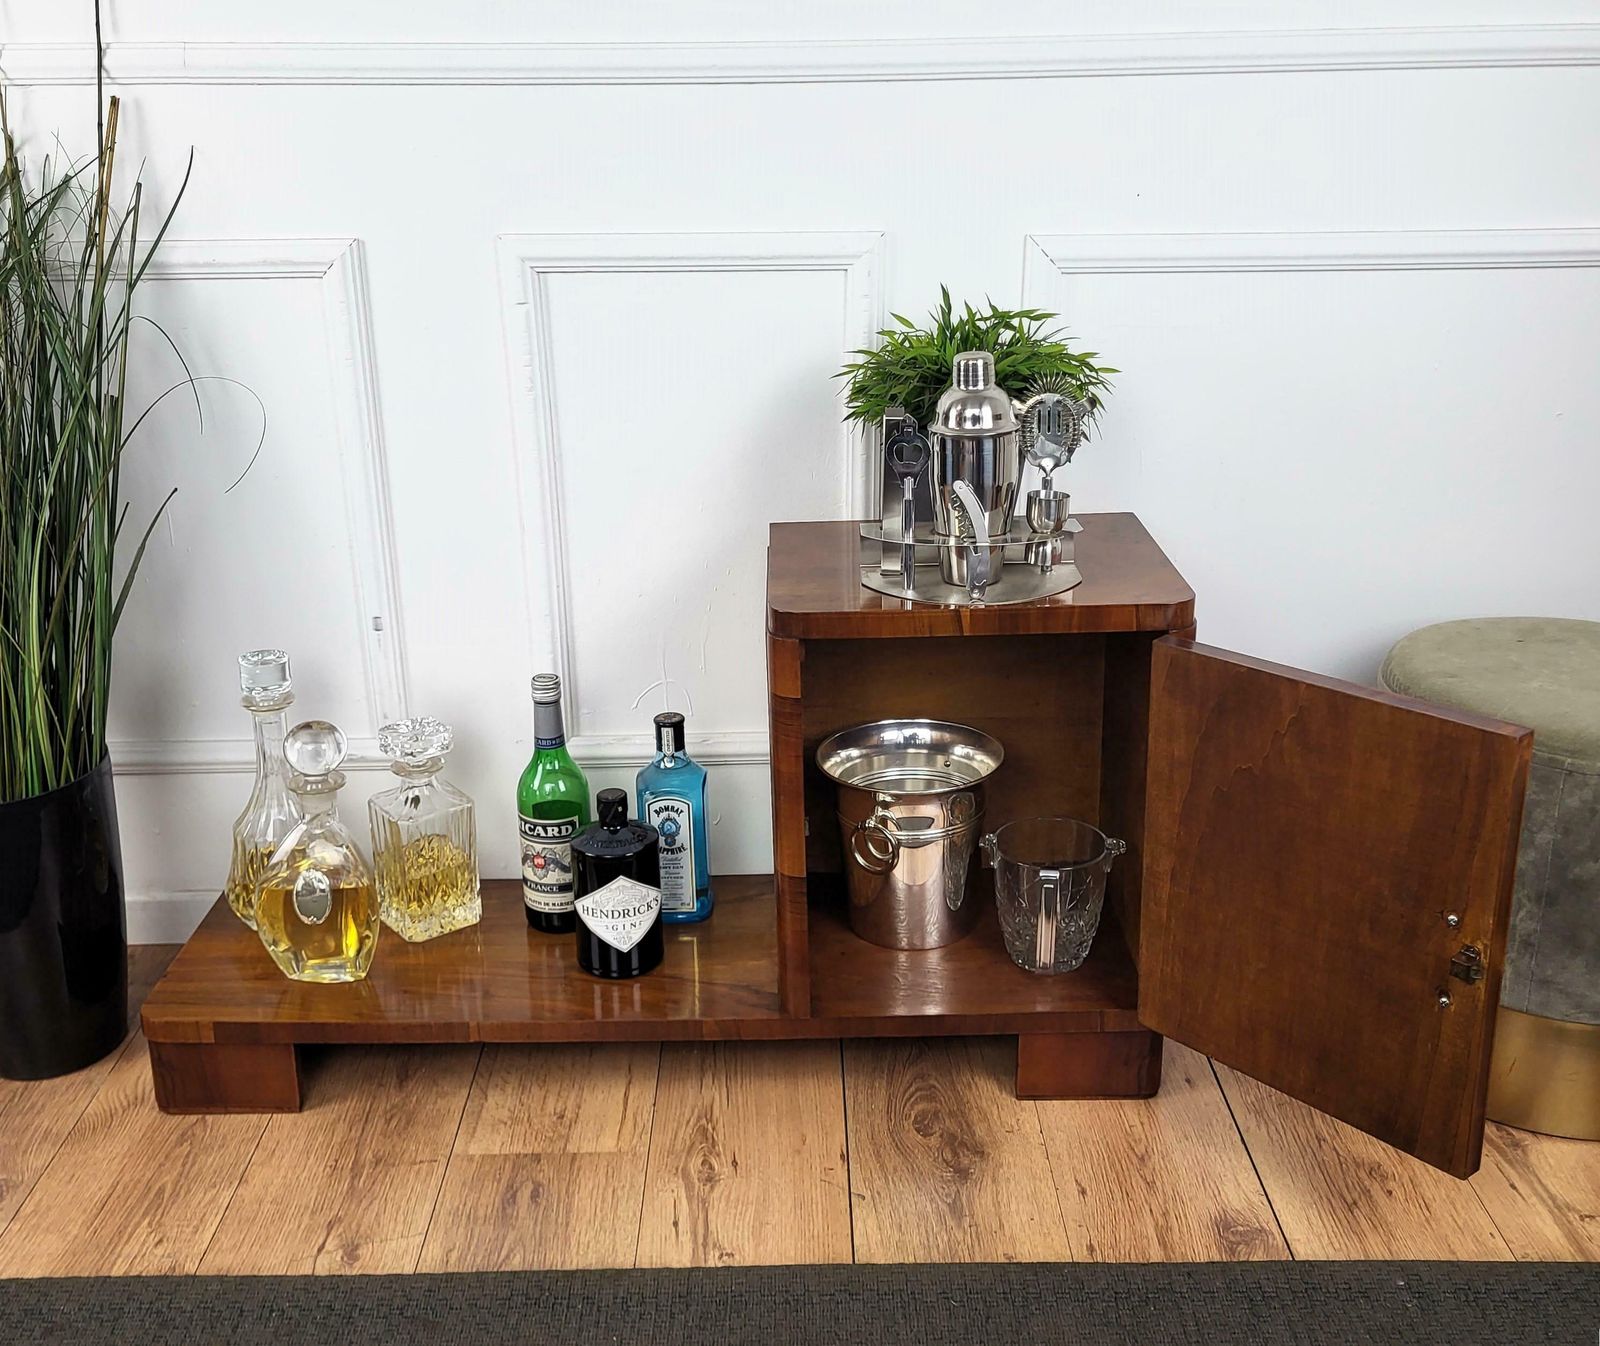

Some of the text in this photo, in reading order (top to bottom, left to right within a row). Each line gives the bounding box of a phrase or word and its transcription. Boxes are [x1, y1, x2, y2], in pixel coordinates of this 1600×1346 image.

[653, 805, 684, 817] BOMBAY
[519, 821, 573, 837] ICARD
[527, 881, 559, 892] FRANCE
[582, 896, 659, 920] HENDRICK'S
[611, 921, 637, 932] GIN
